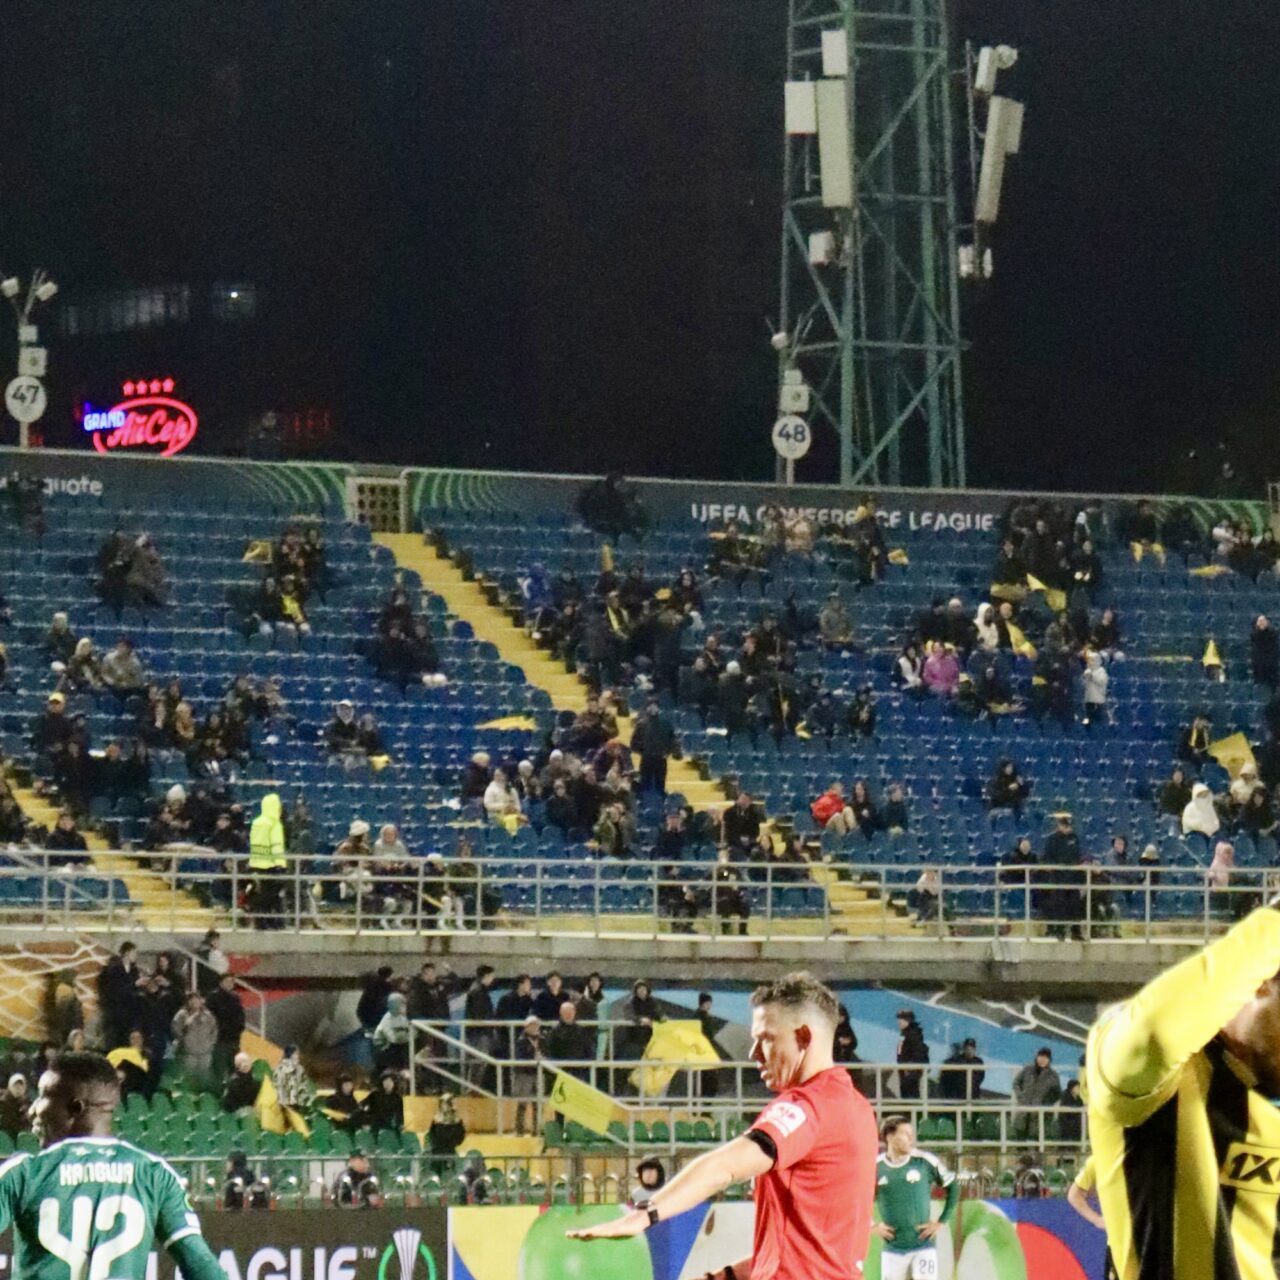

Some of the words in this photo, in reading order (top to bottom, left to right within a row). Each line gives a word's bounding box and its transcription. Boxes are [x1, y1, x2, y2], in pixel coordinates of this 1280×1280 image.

[12, 384, 39, 404] 47
[84, 410, 125, 431] GRAND
[777, 424, 806, 443] 48
[691, 503, 752, 525] UEFA
[909, 511, 994, 532] LEAGUE
